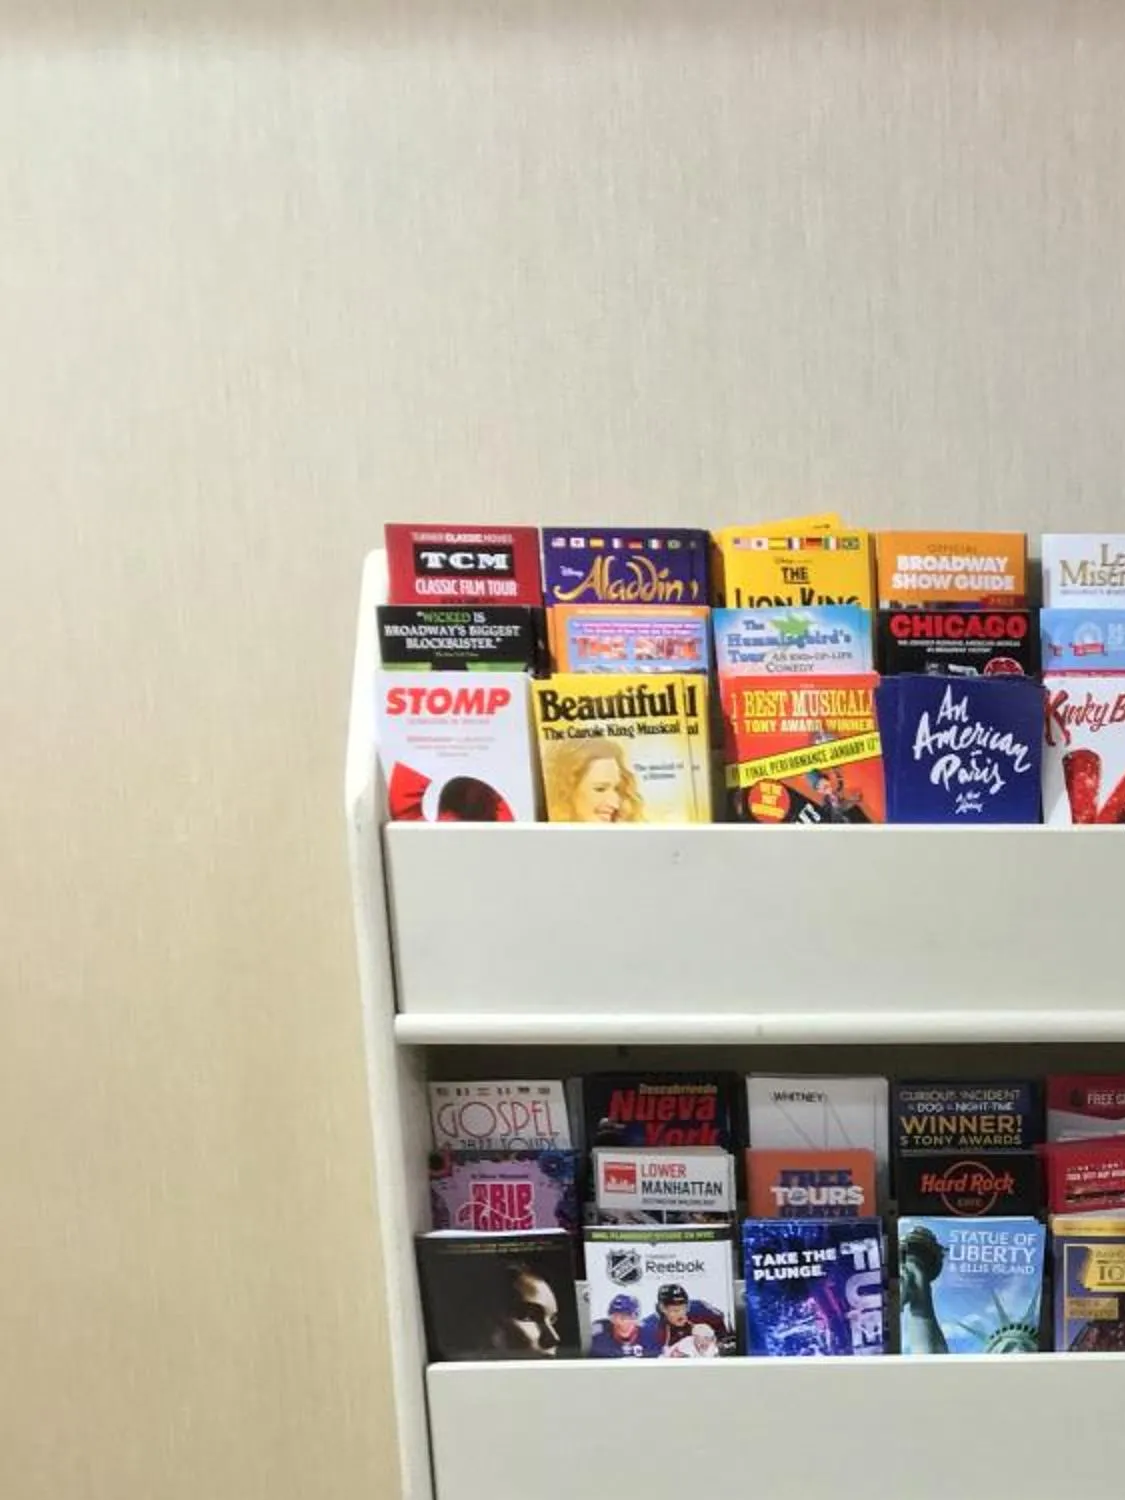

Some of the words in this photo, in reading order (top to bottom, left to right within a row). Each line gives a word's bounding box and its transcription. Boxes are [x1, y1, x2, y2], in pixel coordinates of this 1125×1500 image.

[421, 552, 509, 570] TCM
[897, 556, 1008, 572] BROADWAY
[554, 555, 682, 601] Aladdin
[781, 567, 809, 584] THE
[892, 574, 951, 589] SHOW
[956, 575, 1014, 590] GUIDE
[416, 580, 457, 594] CLASSIC
[460, 580, 487, 595] FILM
[488, 581, 517, 595] TOUR
[385, 625, 466, 636] BROADWAY'S
[470, 625, 520, 636] BIGGEST
[744, 620, 765, 630] The
[891, 616, 1027, 638] CHICAGO
[406, 637, 502, 649] BLOCKBUSTER."
[727, 632, 852, 649] Hummingbird's
[728, 651, 766, 663] Tour
[766, 663, 813, 672] COMEDY
[386, 687, 511, 715] STOMP
[537, 683, 678, 722] Beautiful
[745, 690, 792, 716] BEST
[937, 684, 968, 724] An
[1044, 689, 1109, 746] Kinky
[543, 728, 565, 740] The
[567, 727, 604, 738] Carole
[607, 725, 635, 738] King
[637, 722, 681, 736] Musical
[913, 713, 1031, 773] American
[745, 762, 768, 778] FINAL
[770, 750, 827, 773] PERFORMANCE
[830, 741, 865, 760] JANUARY
[931, 751, 1006, 793] Paris
[774, 1091, 824, 1102] WHITNEY
[1088, 1094, 1114, 1105] FREE
[607, 1089, 717, 1122] Nueva
[917, 1103, 944, 1113] DOG
[437, 1101, 560, 1140] GOSPEL
[902, 1116, 1023, 1134] WINNER!
[645, 1122, 720, 1146] York
[914, 1136, 952, 1146] TONY
[959, 1135, 1021, 1146] AWARDS
[641, 1164, 686, 1177] LOWER
[641, 1181, 722, 1195] MANHATTAN
[921, 1173, 967, 1194] Hard
[971, 1174, 1016, 1197] Rock
[770, 1186, 865, 1206] TOURS
[950, 1230, 1010, 1245] STATUE
[1015, 1234, 1037, 1245] OF
[752, 1253, 798, 1267] TAKE
[804, 1248, 836, 1263] THE
[950, 1246, 1036, 1263] LIBERTY
[645, 1259, 705, 1273] Reebok
[754, 1265, 826, 1281] PLUNGE.
[959, 1261, 989, 1273] ELLIS
[991, 1262, 1035, 1274] ISLAND
